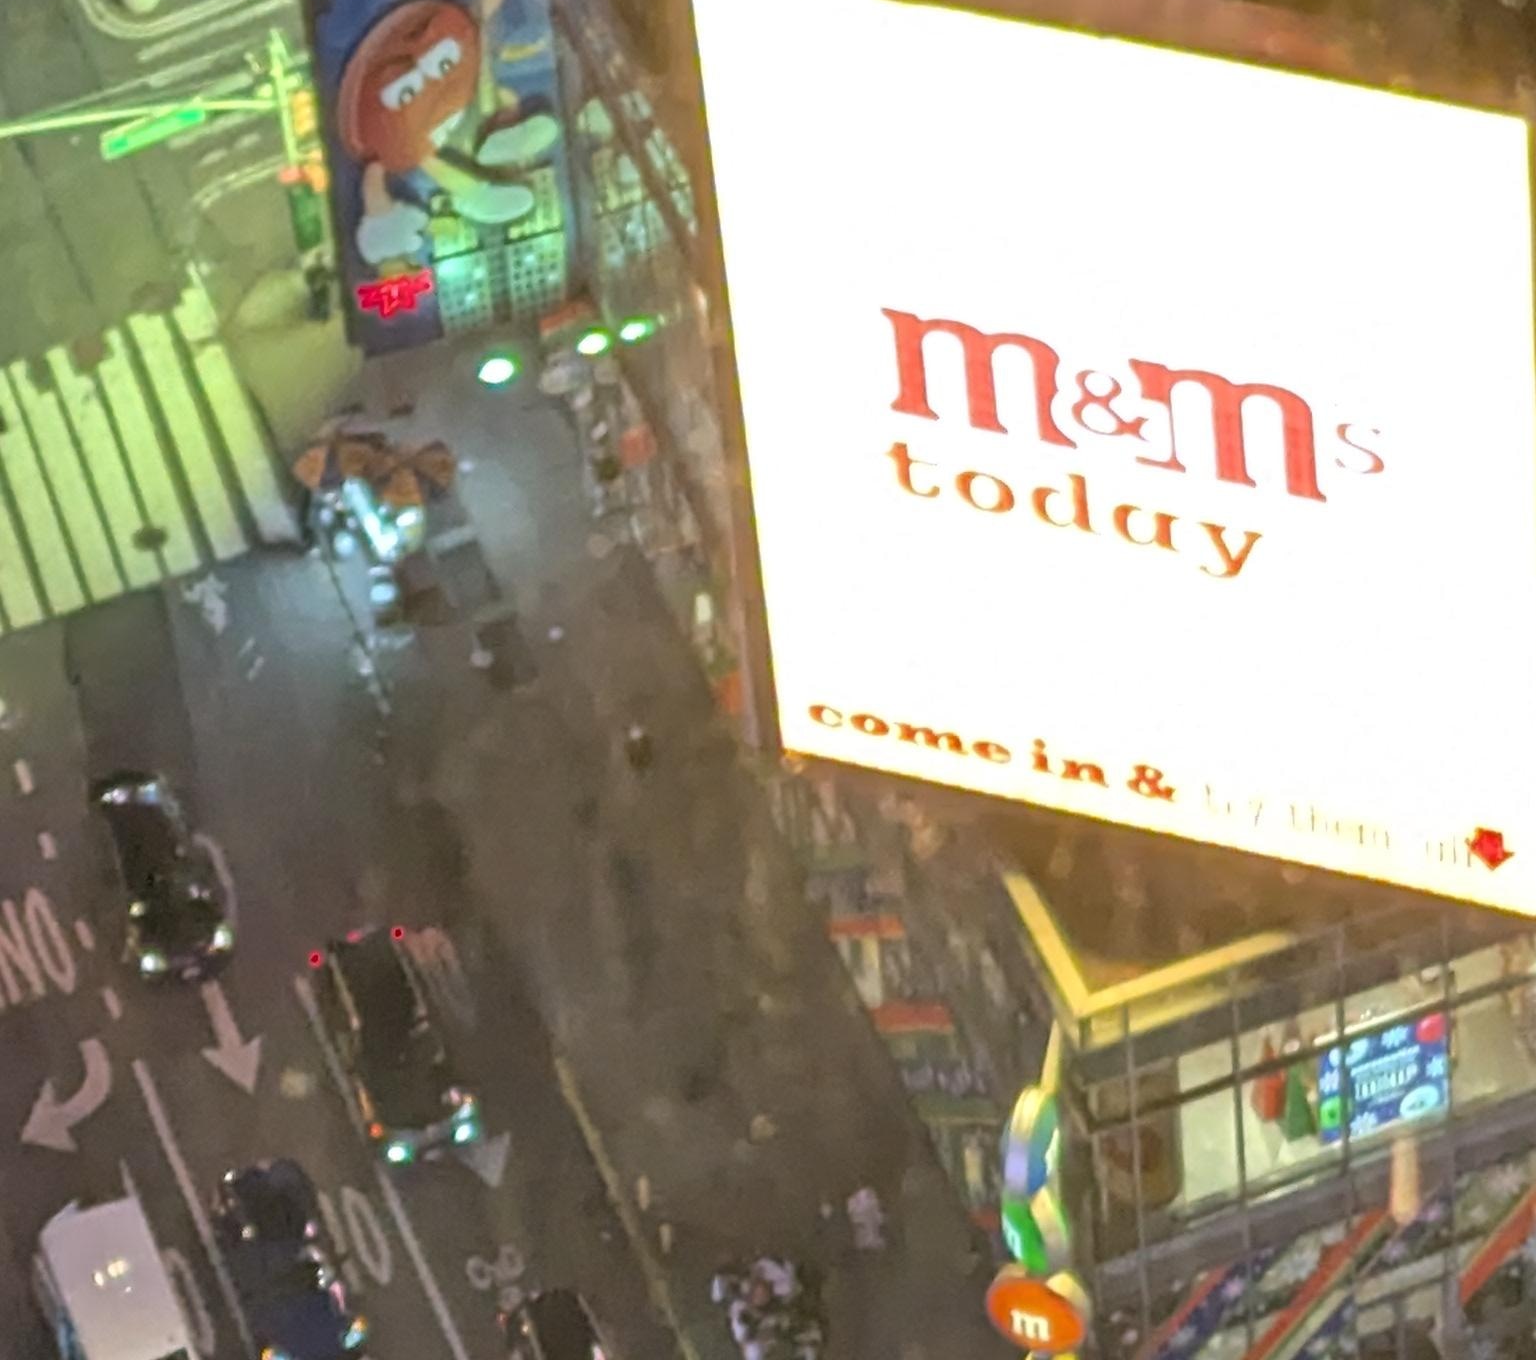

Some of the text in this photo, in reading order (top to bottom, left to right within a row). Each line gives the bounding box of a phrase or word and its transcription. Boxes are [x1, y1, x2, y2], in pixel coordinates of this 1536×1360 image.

[884, 440, 1264, 579] today
[808, 704, 1012, 764] come
[1031, 737, 1109, 788] in
[1127, 763, 1178, 803] &
[1009, 1308, 1051, 1343] m
